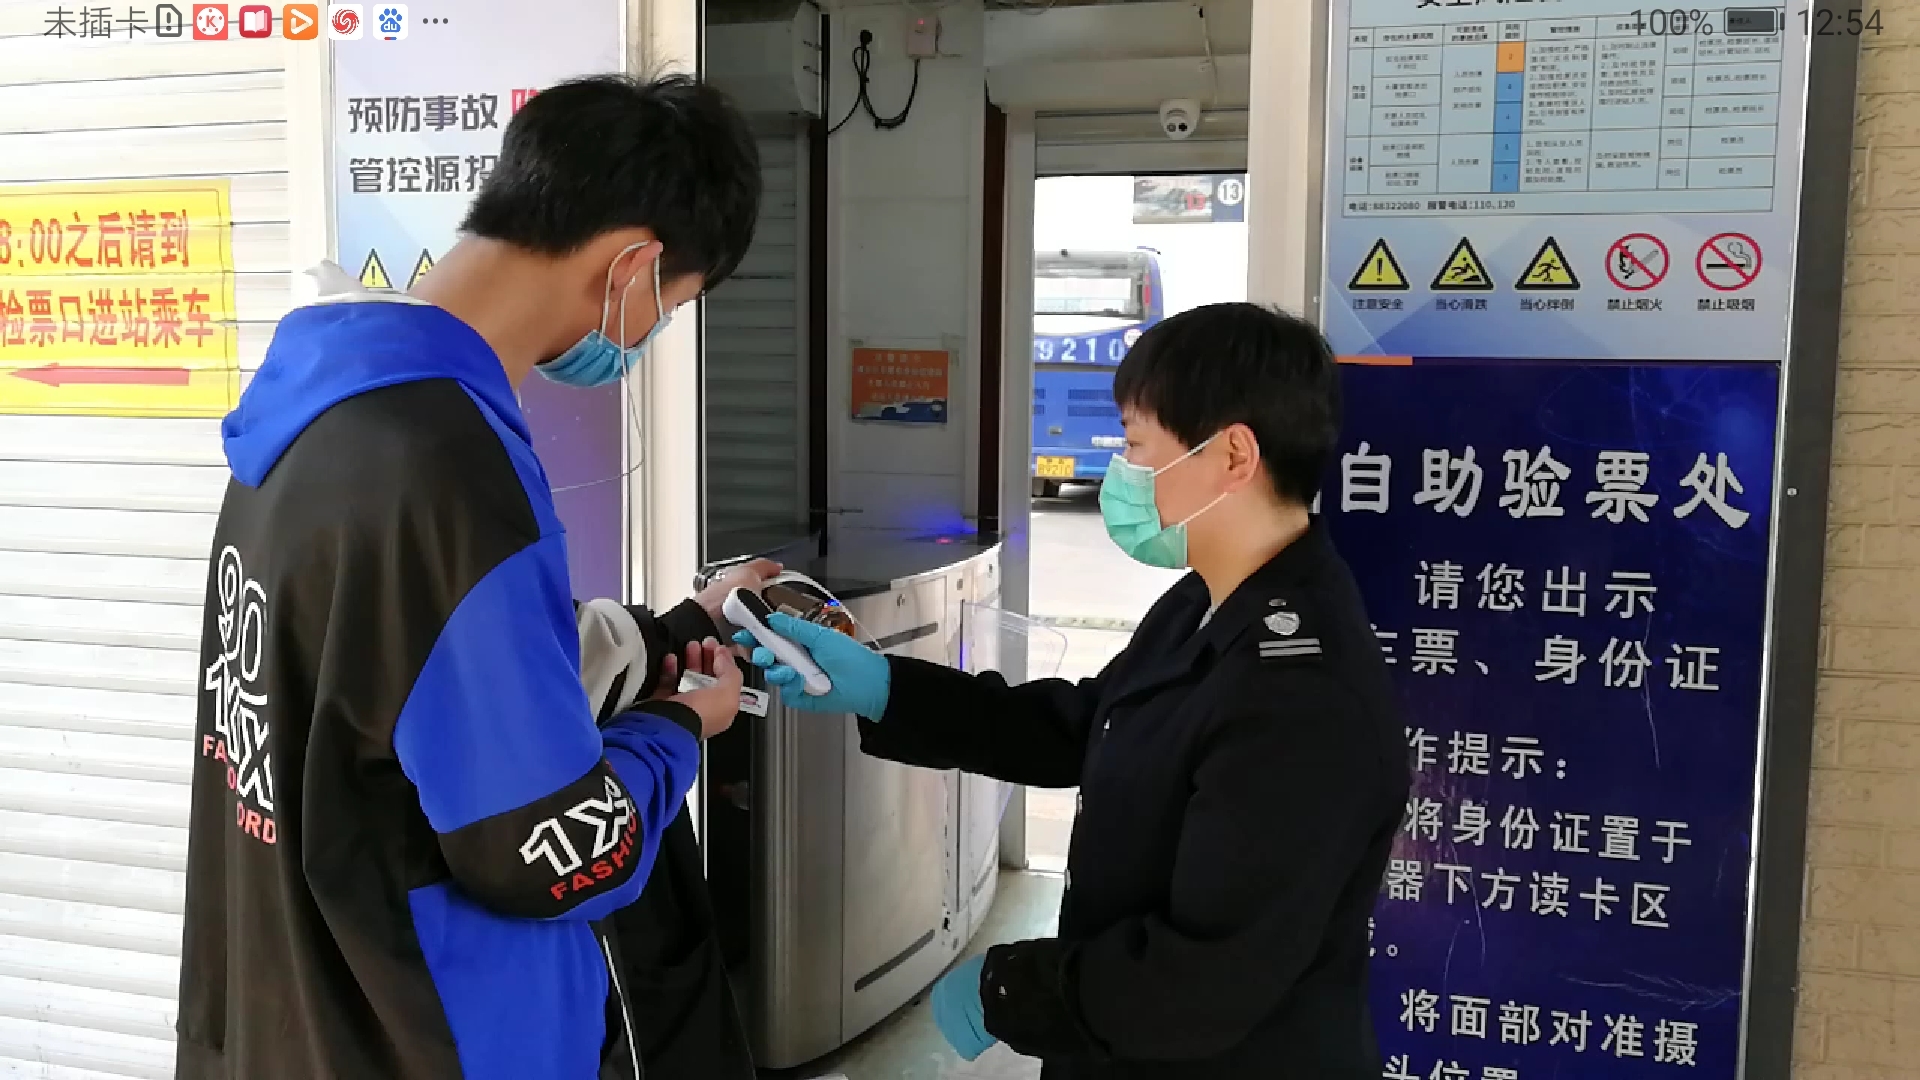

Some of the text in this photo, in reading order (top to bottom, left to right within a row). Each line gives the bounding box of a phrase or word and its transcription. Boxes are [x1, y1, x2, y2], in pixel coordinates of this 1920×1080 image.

[347, 94, 499, 133] 预防事故
[1222, 183, 1240, 201] 13
[0, 287, 214, 349] 检票口进站乘车
[1413, 559, 1659, 619] 请您出示
[1402, 796, 1693, 865] 将身份证置于
[1385, 858, 1672, 930] 器下方读卡区
[1399, 988, 1699, 1068] 将面部对准摄
